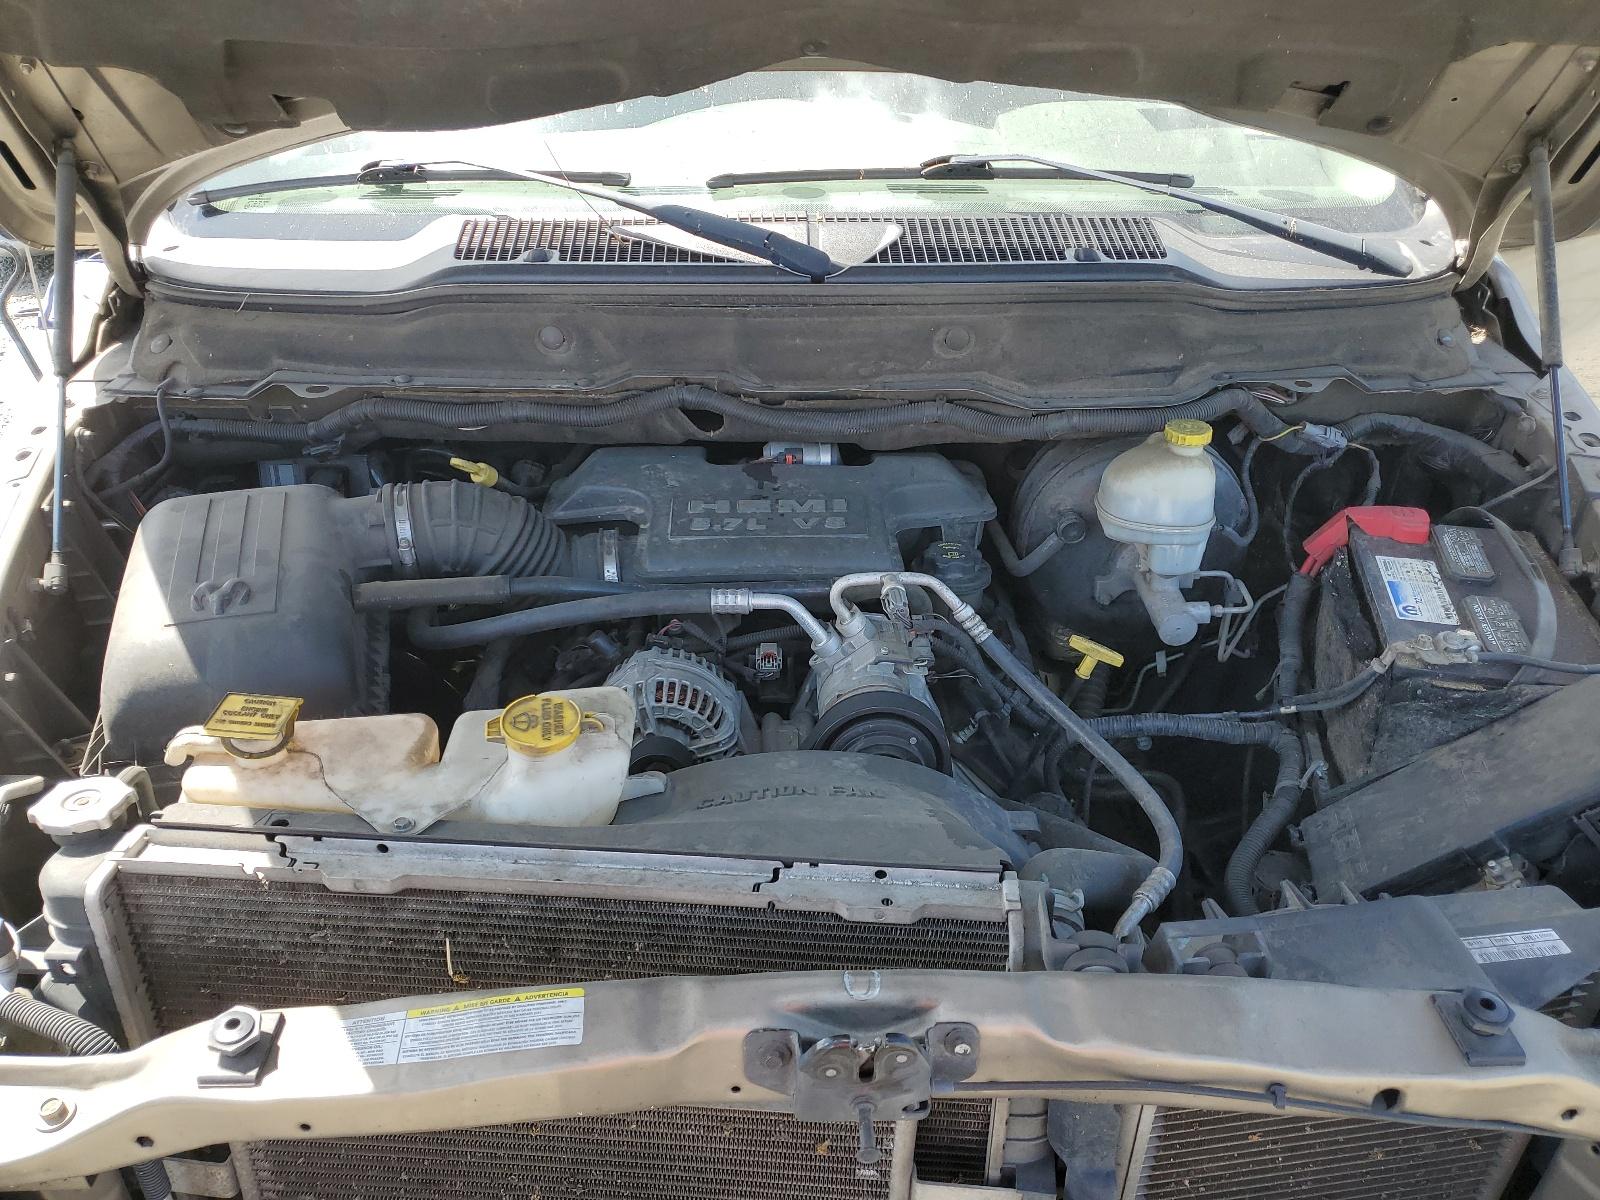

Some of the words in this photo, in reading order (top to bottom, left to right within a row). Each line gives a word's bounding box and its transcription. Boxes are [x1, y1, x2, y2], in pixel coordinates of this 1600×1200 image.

[687, 499, 848, 513] HEMI
[792, 516, 847, 529] V8
[696, 785, 817, 810] CAUTION
